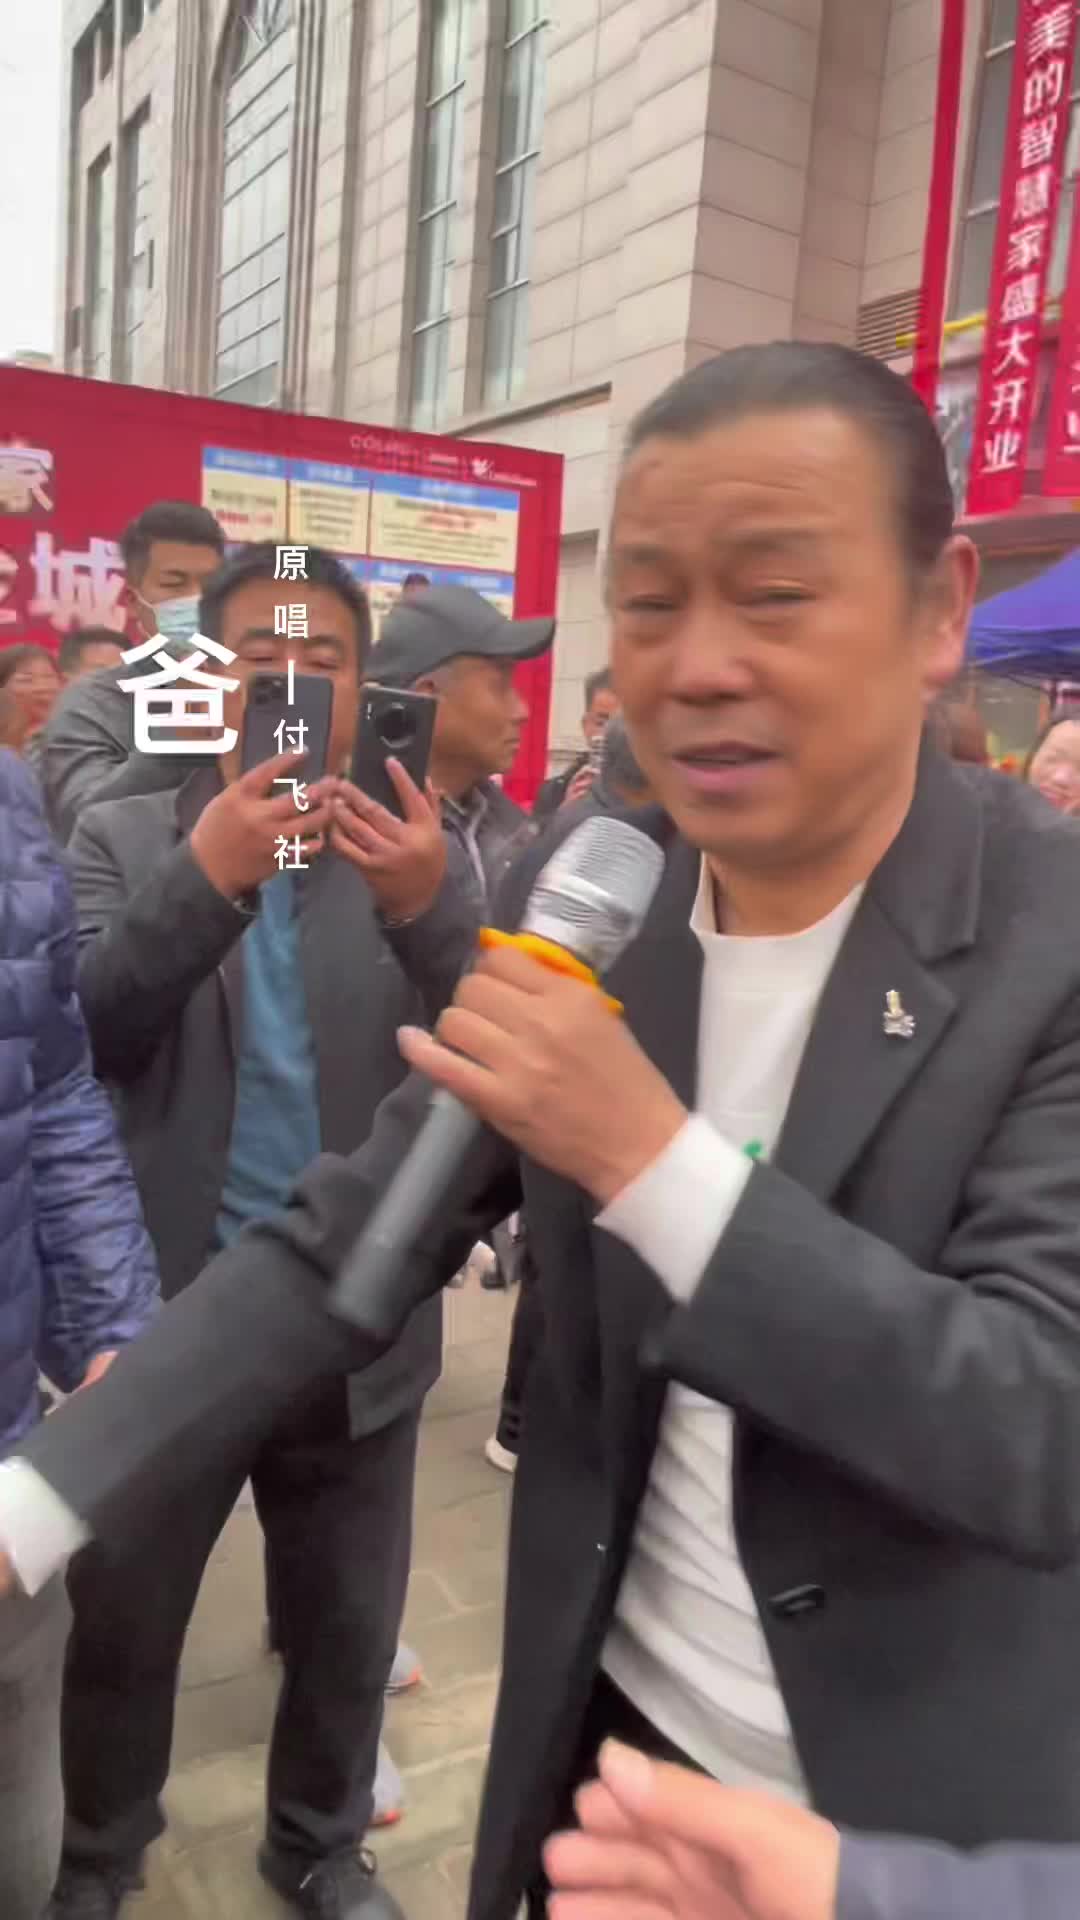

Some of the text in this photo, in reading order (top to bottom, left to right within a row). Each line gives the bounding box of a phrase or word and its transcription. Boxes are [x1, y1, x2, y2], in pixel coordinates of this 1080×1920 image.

[981, 0, 1073, 473] 美的智慧家盛大开业
[0, 531, 127, 632] 城
